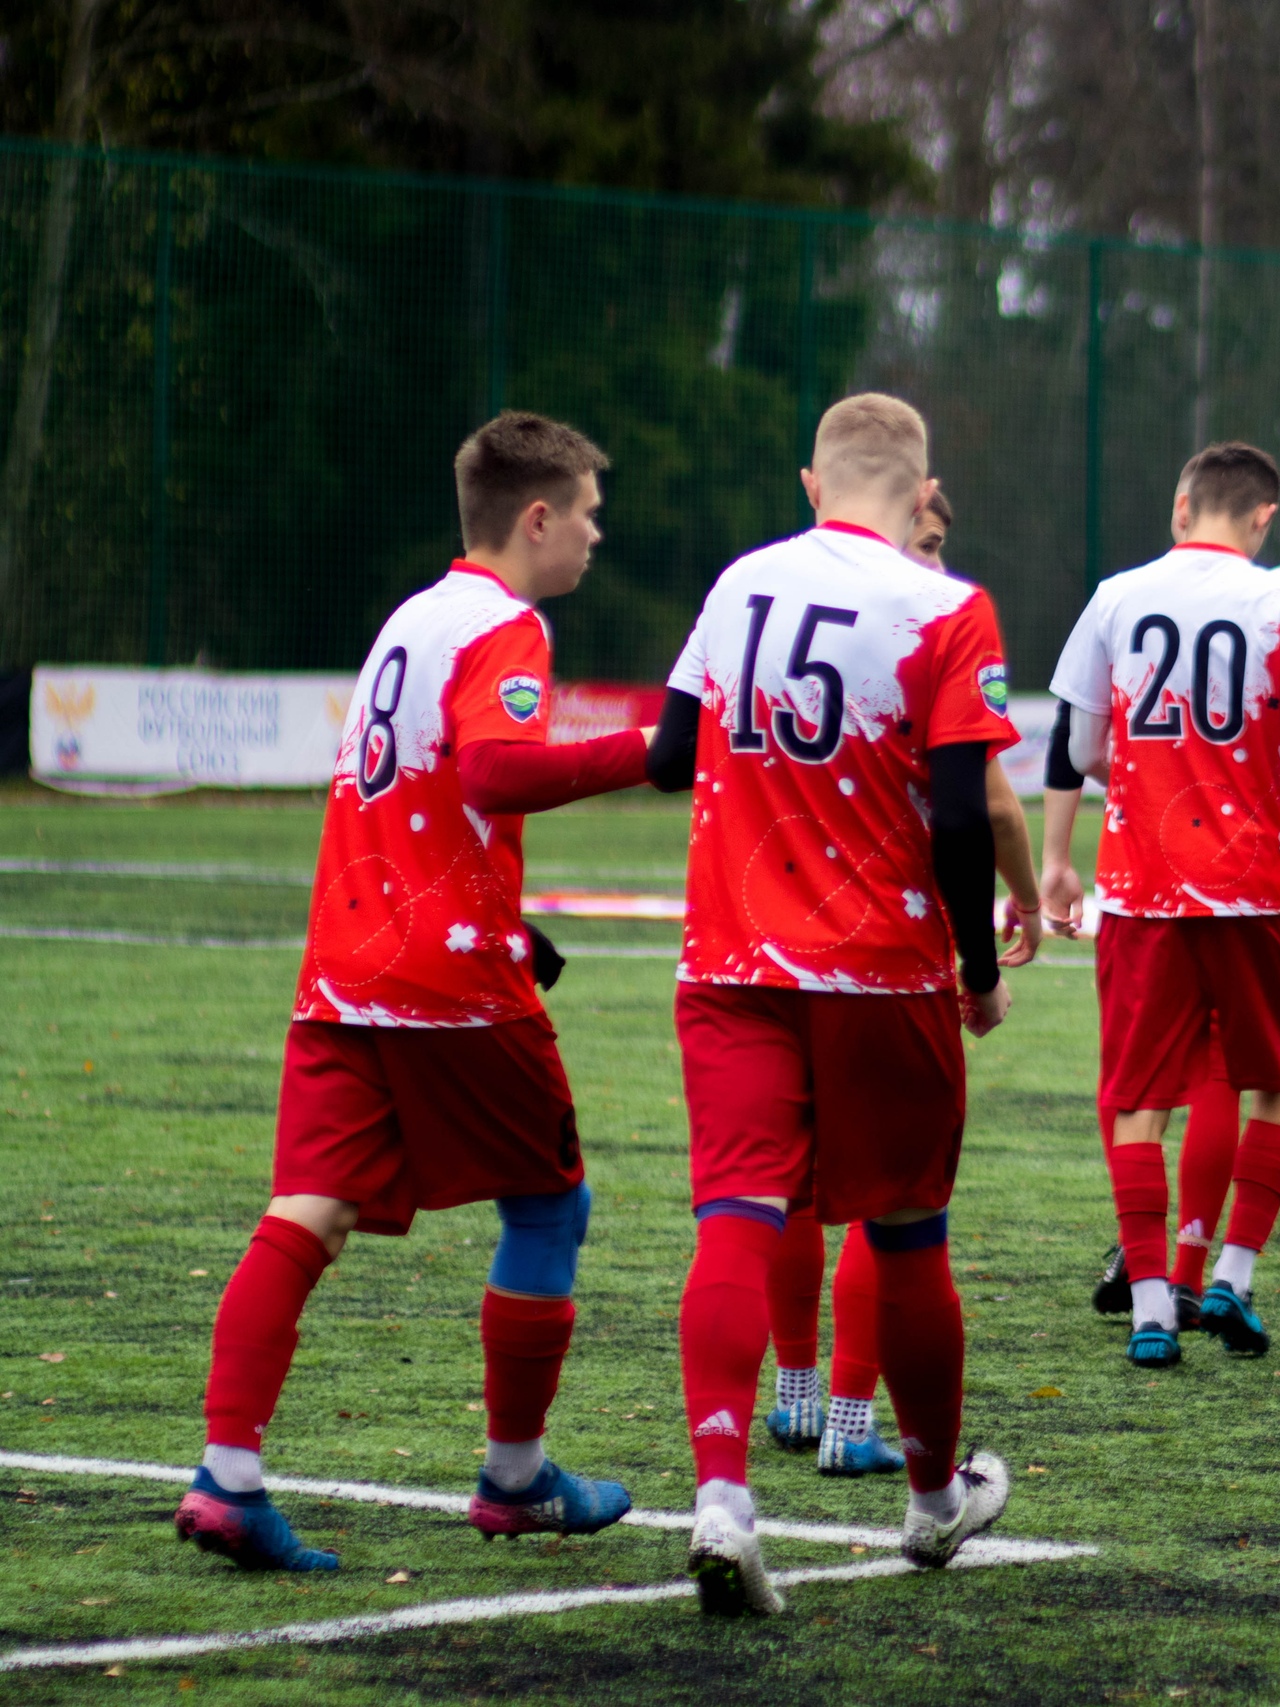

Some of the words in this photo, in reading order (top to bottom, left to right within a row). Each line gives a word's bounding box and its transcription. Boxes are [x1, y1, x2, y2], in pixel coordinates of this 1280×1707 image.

[356, 645, 407, 802] 8
[730, 594, 859, 764] 15
[1128, 613, 1248, 745] 20
[1134, 1331, 1167, 1359] NIKE
[694, 1425, 741, 1438] adidas
